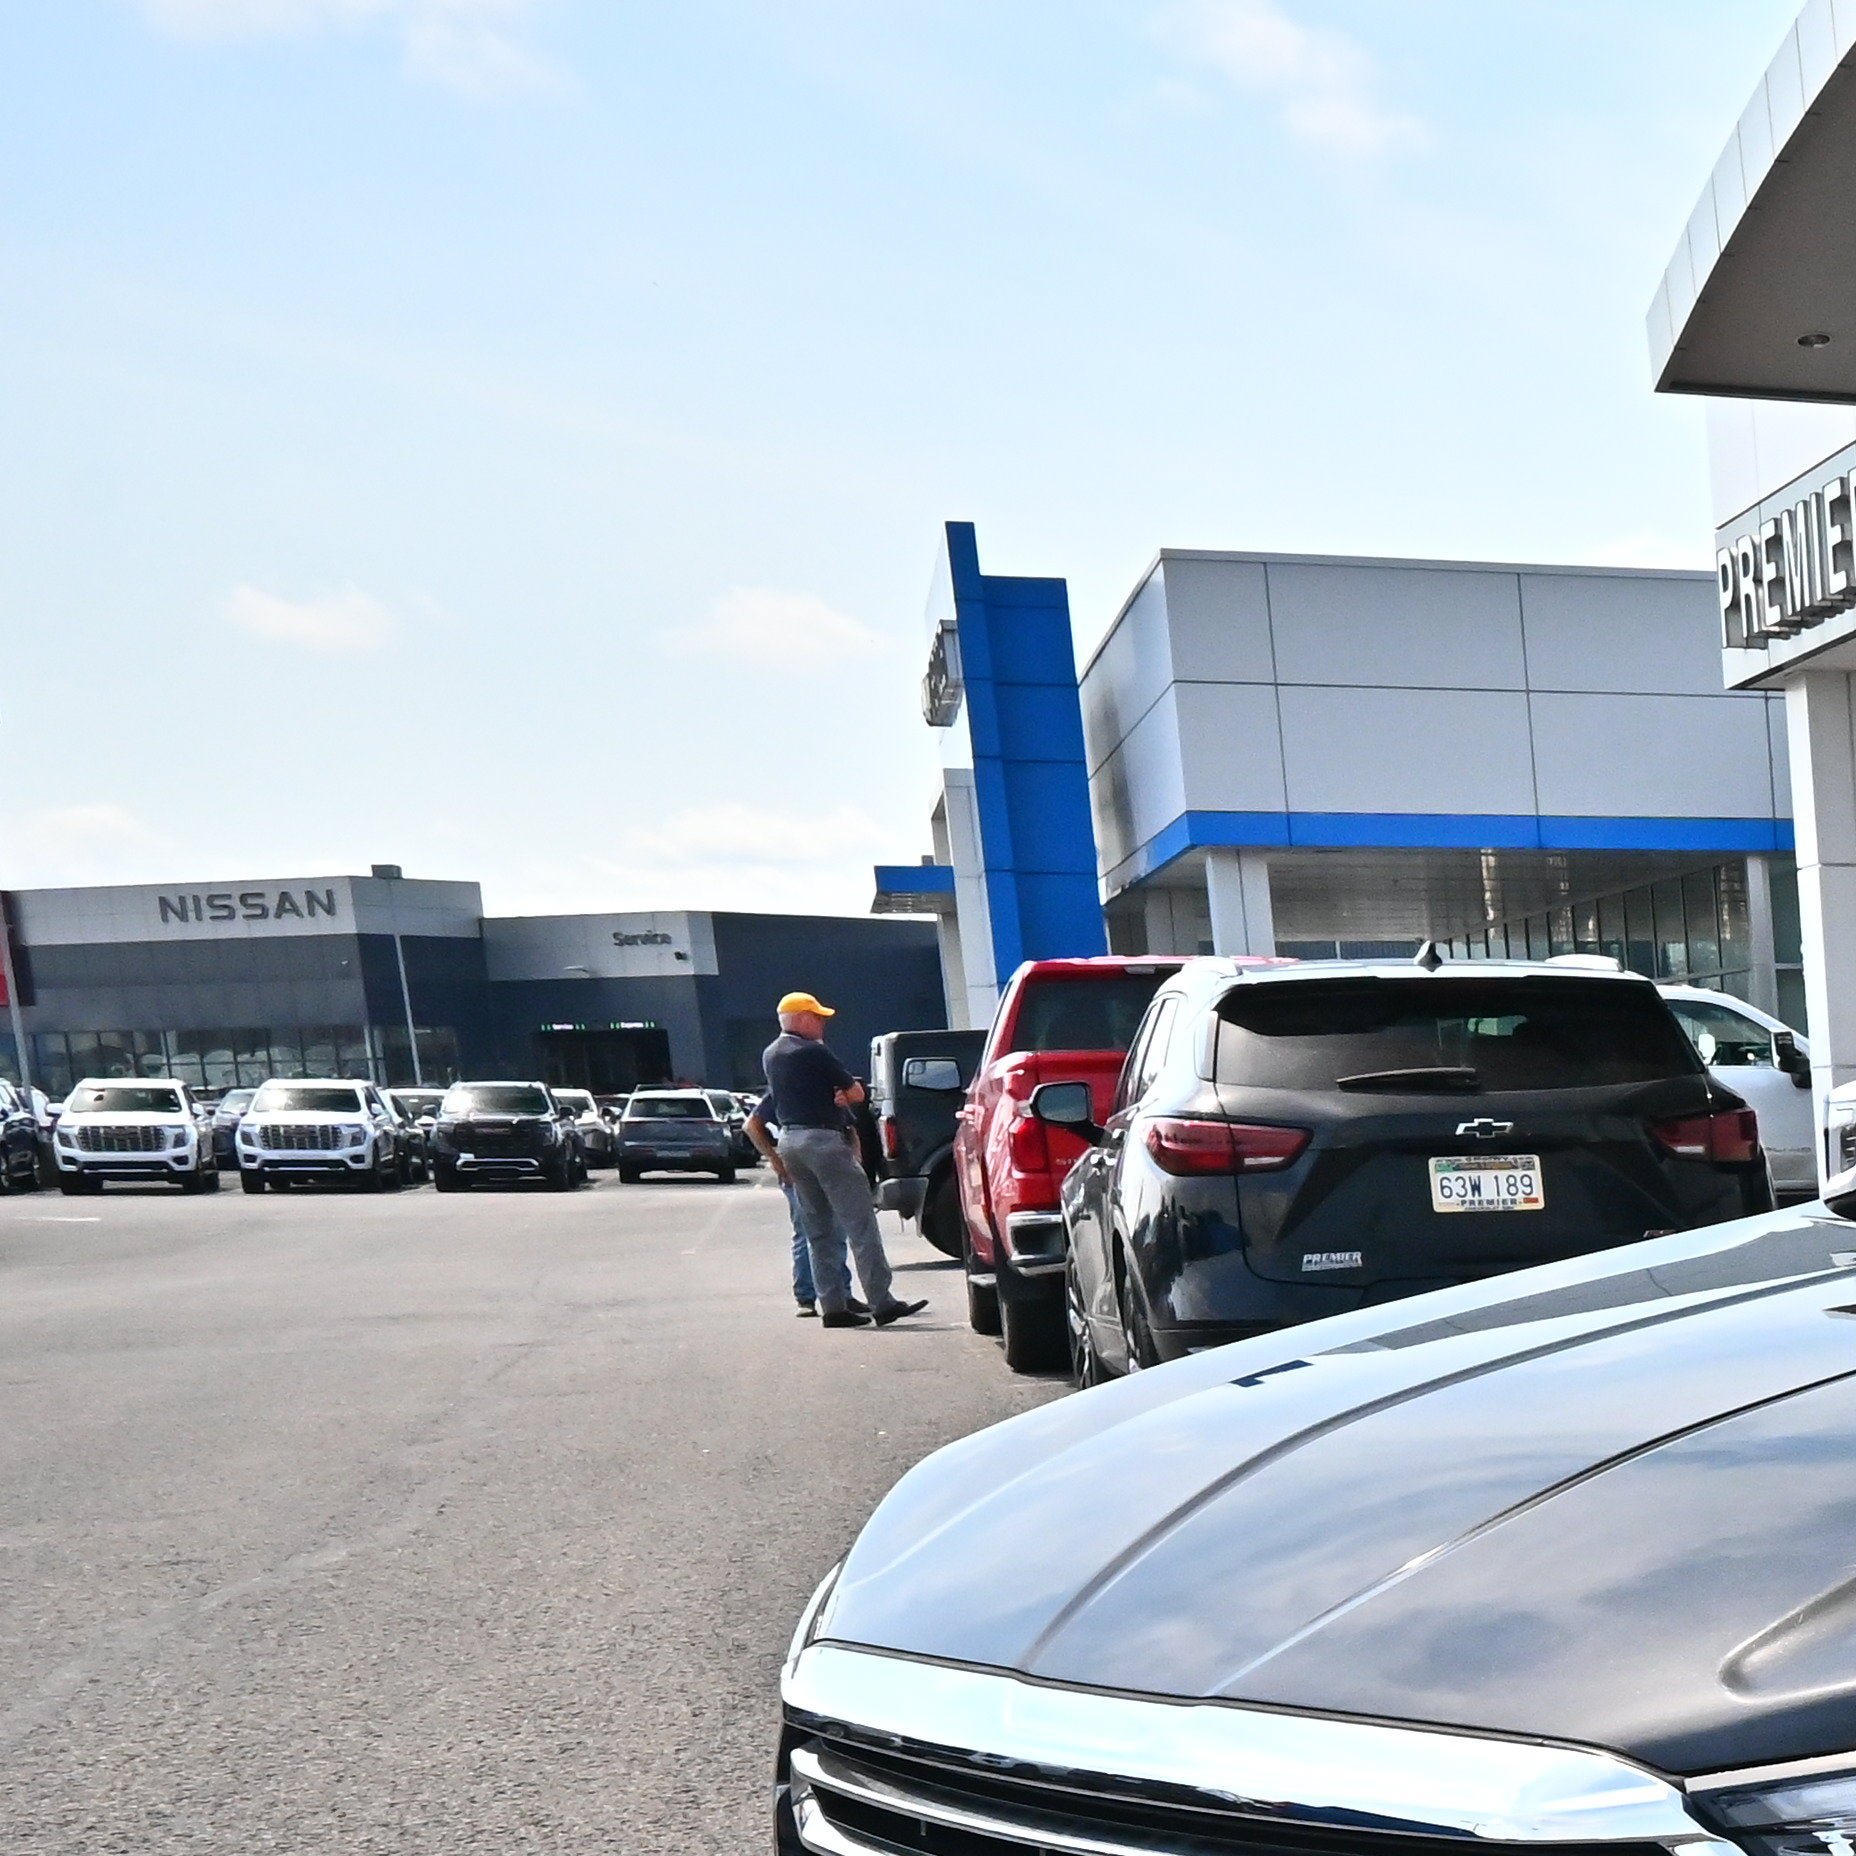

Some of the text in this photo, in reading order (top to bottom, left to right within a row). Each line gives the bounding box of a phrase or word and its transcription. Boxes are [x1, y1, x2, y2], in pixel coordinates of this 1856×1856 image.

[157, 888, 337, 924] NISSAN
[612, 929, 673, 947] Service
[1439, 1173, 1534, 1199] 63W 189
[1460, 1197, 1518, 1207] PREMIER
[1303, 1251, 1362, 1266] PREMIER
